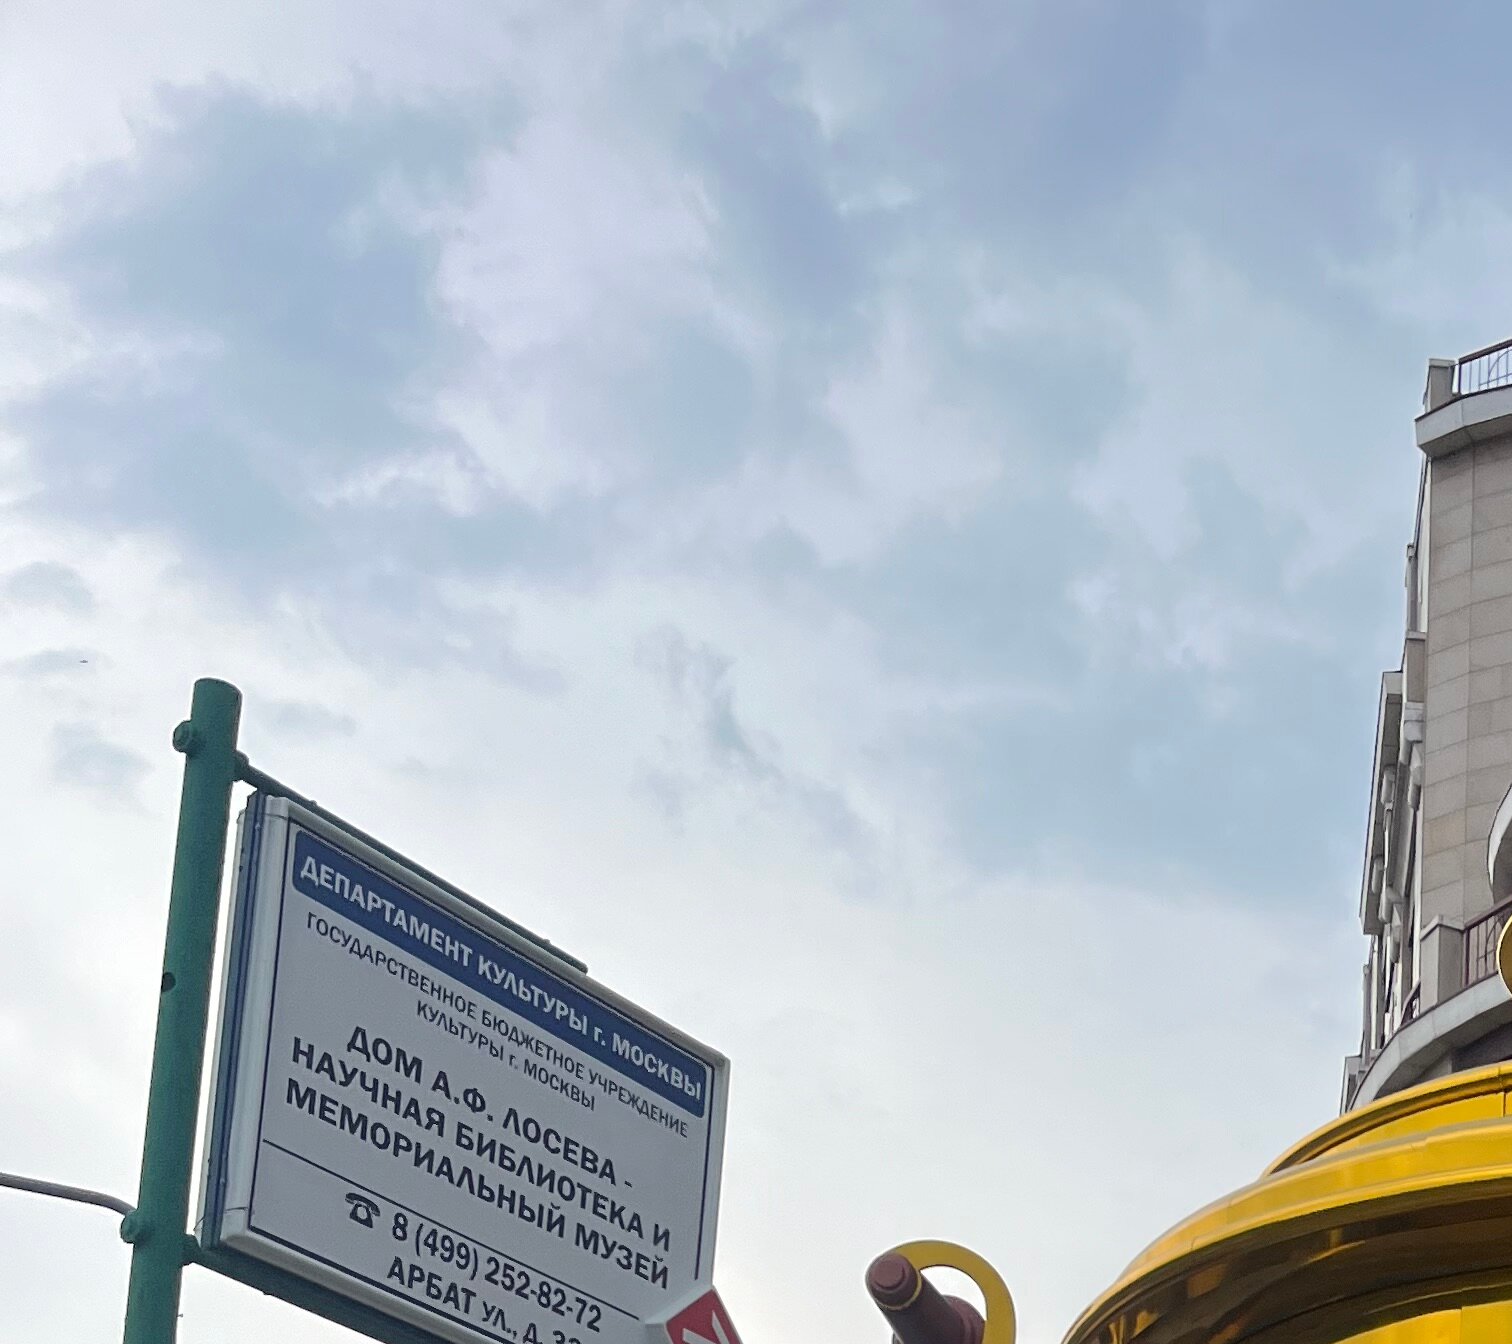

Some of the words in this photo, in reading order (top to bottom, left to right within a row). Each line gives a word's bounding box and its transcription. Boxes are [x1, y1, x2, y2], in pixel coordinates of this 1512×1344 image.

[300, 855, 473, 967] ДЕПАРТАМЕНТ
[478, 955, 588, 1035] КУЛЬТУРЫ
[593, 1027, 606, 1046] г.
[612, 1032, 701, 1100] МОСКВЫ
[307, 911, 477, 1019] ГОСУДАРСТВЕННОЕ
[481, 1009, 584, 1080] БЮДЖЕТНОЕ
[589, 1068, 689, 1138] УЧРЕЖДЕНИЕ
[417, 1000, 504, 1061] КУЛЬТУРЫ
[523, 1059, 595, 1111] МОСКВЫ
[286, 1077, 566, 1238] МЕМОРИАЛЬНЫЙ
[575, 1222, 669, 1291] МУЗЕЙ
[292, 1036, 445, 1138] НАУЧНАЯ
[455, 1121, 644, 1240] БИБЛИОТЕКА
[653, 1223, 671, 1252] И
[346, 1026, 423, 1084] ДОМ
[431, 1070, 494, 1122] А.Ф.
[502, 1107, 617, 1187] ЛОСЕВА
[387, 1256, 476, 1314] АРБАТ
[392, 1212, 408, 1241] 8
[415, 1223, 479, 1281] (499)
[484, 1256, 602, 1333] 252-82-72
